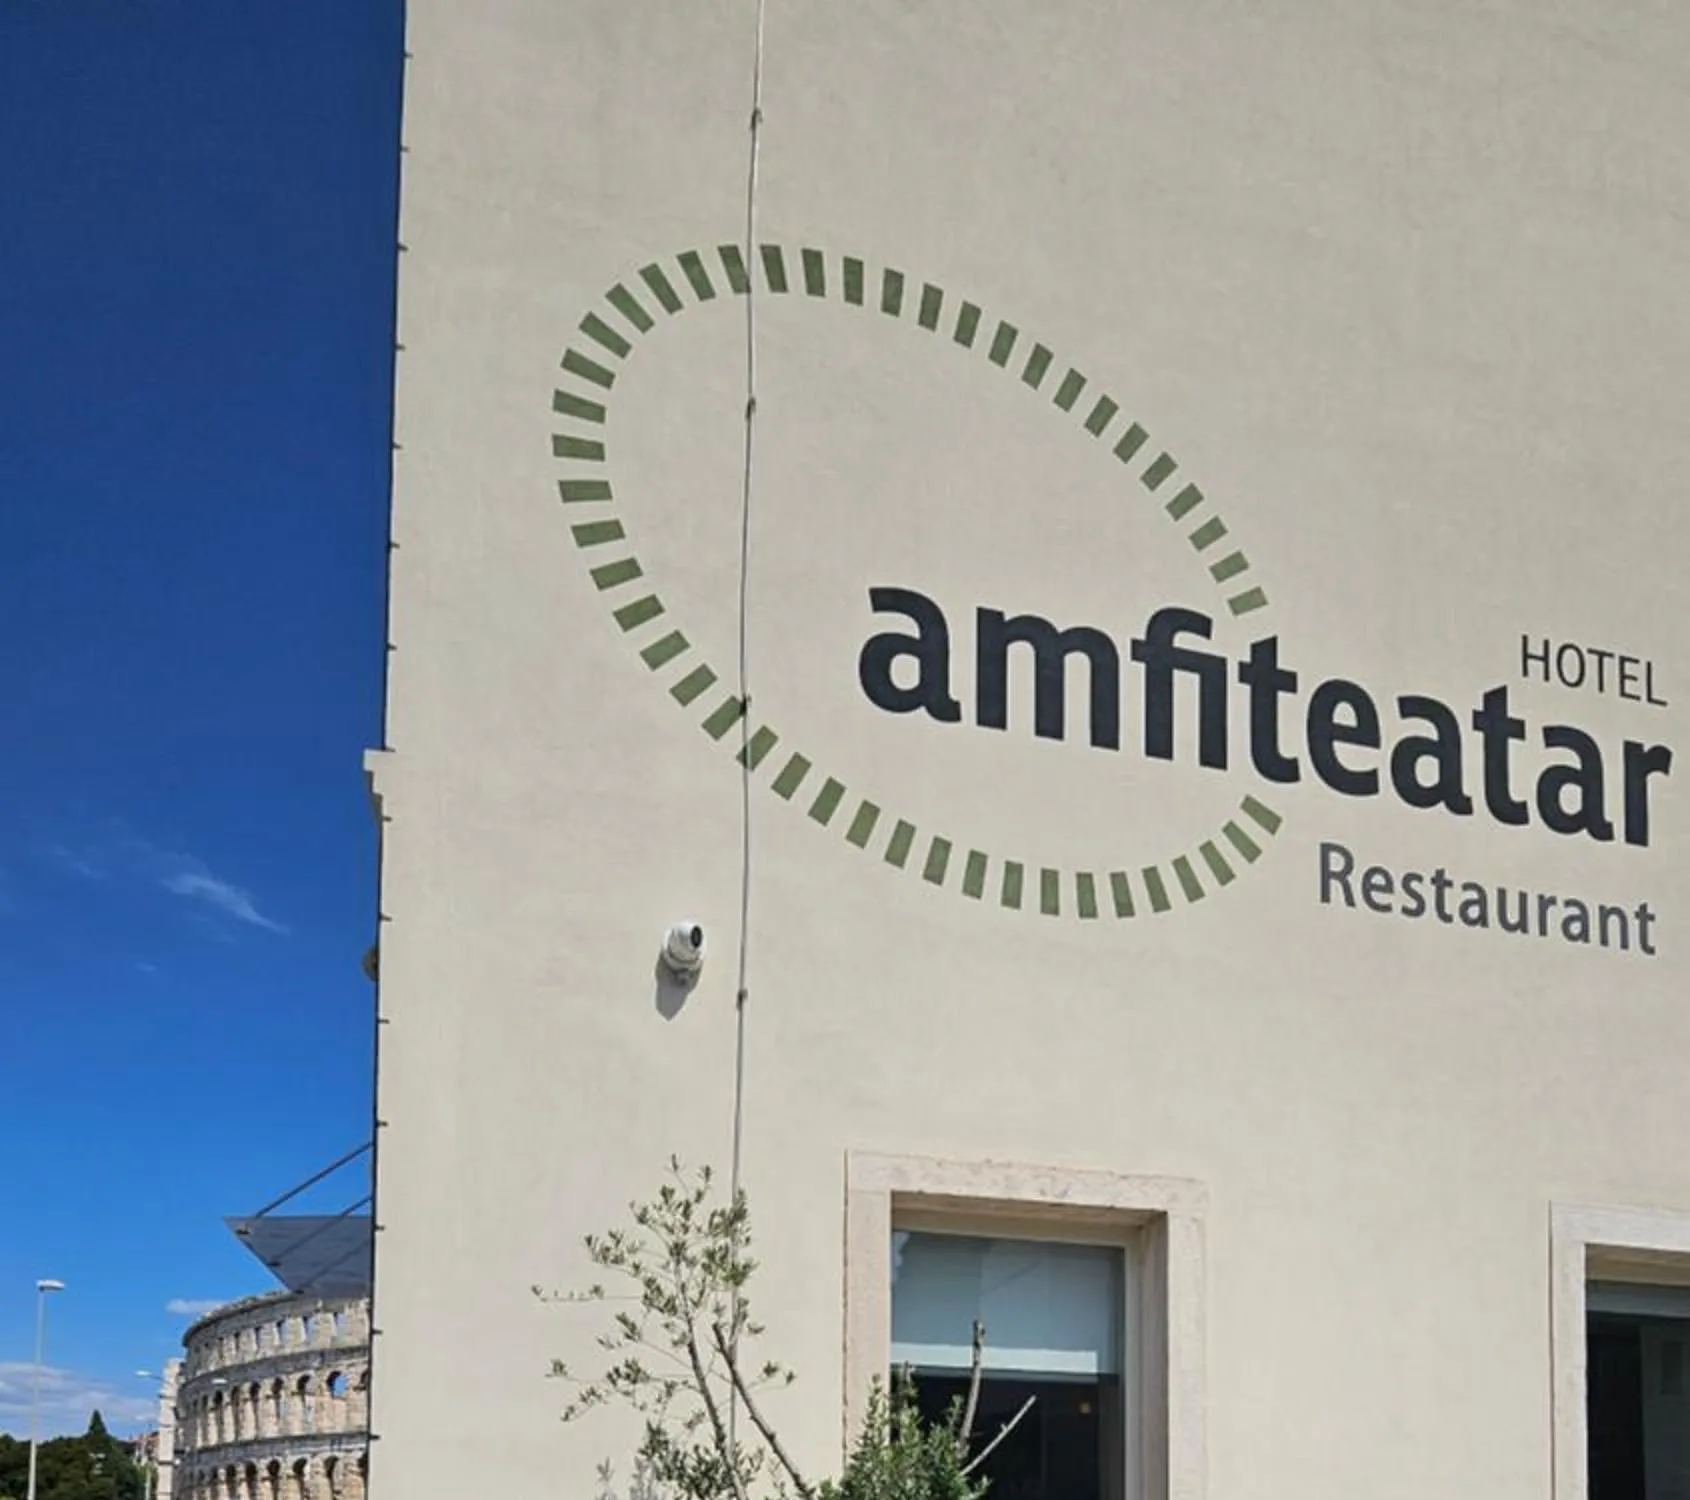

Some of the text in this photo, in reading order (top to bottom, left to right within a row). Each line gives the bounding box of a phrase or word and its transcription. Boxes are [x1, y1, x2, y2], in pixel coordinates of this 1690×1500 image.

[858, 587, 1673, 848] amfiteatar
[1521, 635, 1669, 706] HOTEL
[1318, 842, 1656, 955] Restaurant
